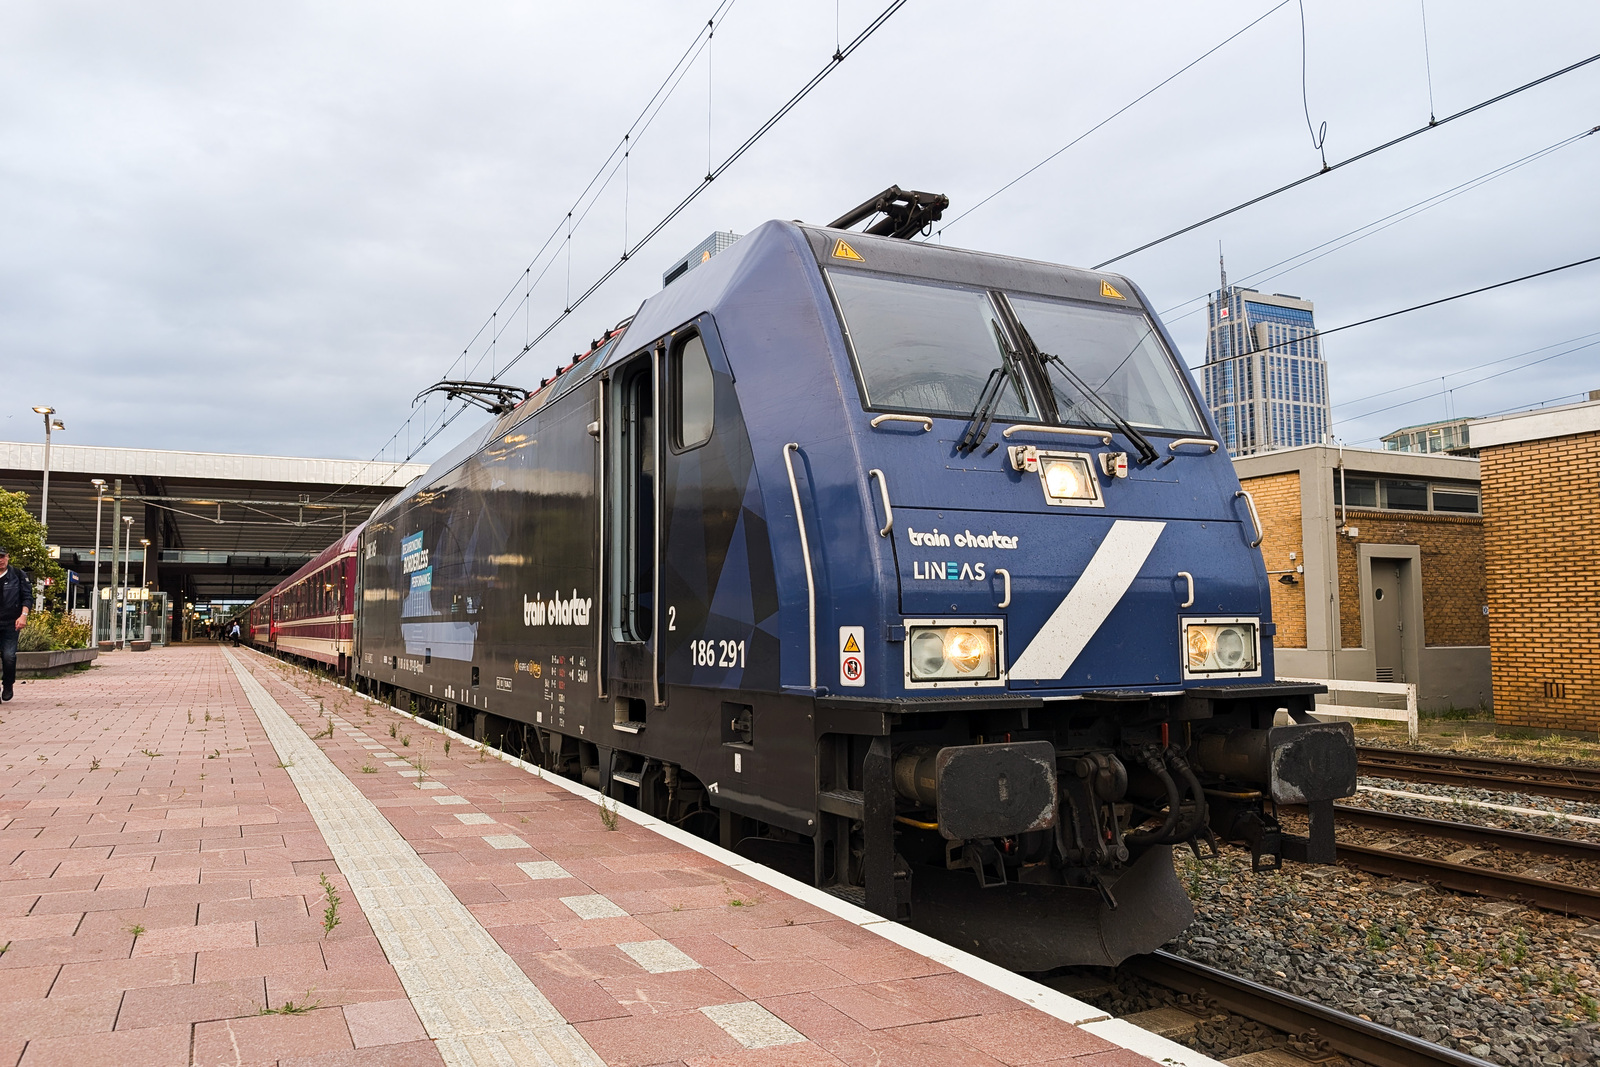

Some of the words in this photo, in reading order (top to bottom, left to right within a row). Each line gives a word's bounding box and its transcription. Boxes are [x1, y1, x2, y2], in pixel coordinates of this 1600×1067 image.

[908, 527, 951, 547] train
[954, 529, 1019, 549] charter
[913, 561, 986, 581] LINEAS
[524, 593, 546, 626] train
[547, 588, 592, 626] charter
[668, 605, 676, 631] 2
[690, 639, 715, 667] 186
[719, 639, 745, 669] 291
